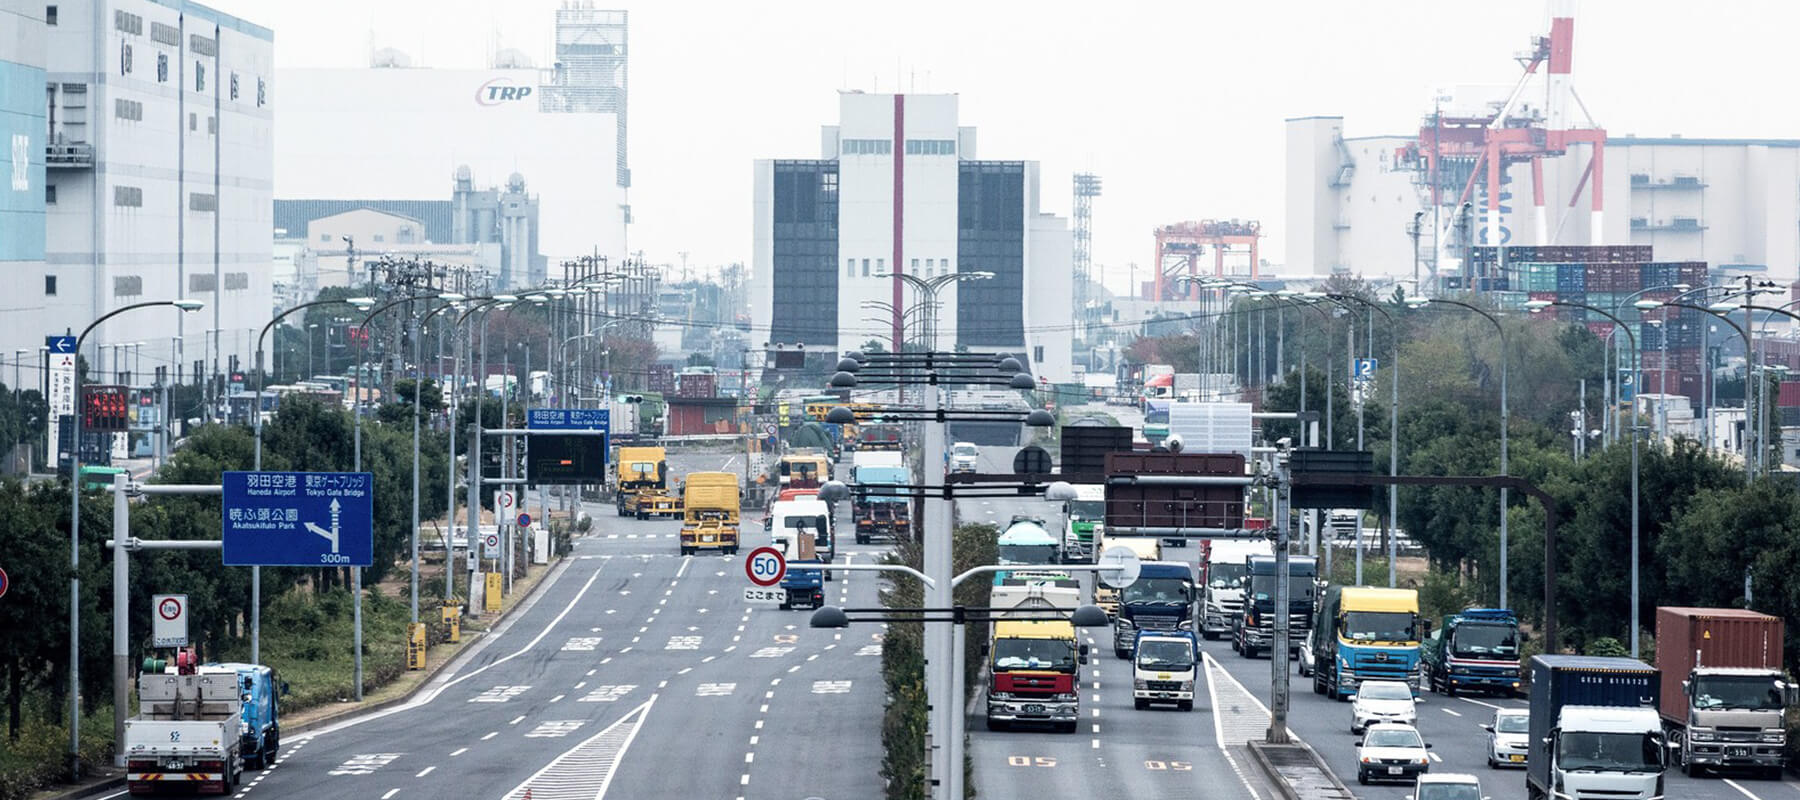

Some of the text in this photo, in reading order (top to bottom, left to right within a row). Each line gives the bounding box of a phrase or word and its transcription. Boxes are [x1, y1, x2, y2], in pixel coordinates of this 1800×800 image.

[487, 86, 532, 100] TRP
[247, 475, 365, 488] 羽田空港 東京ゲートブリッジ
[273, 489, 296, 497] Airport
[306, 489, 326, 497] Tokyo
[343, 489, 365, 497] Bridge
[229, 508, 298, 521] 暁ふ頭公園
[320, 554, 350, 563] 300m
[754, 557, 777, 575] 50
[745, 590, 784, 601] ここまで
